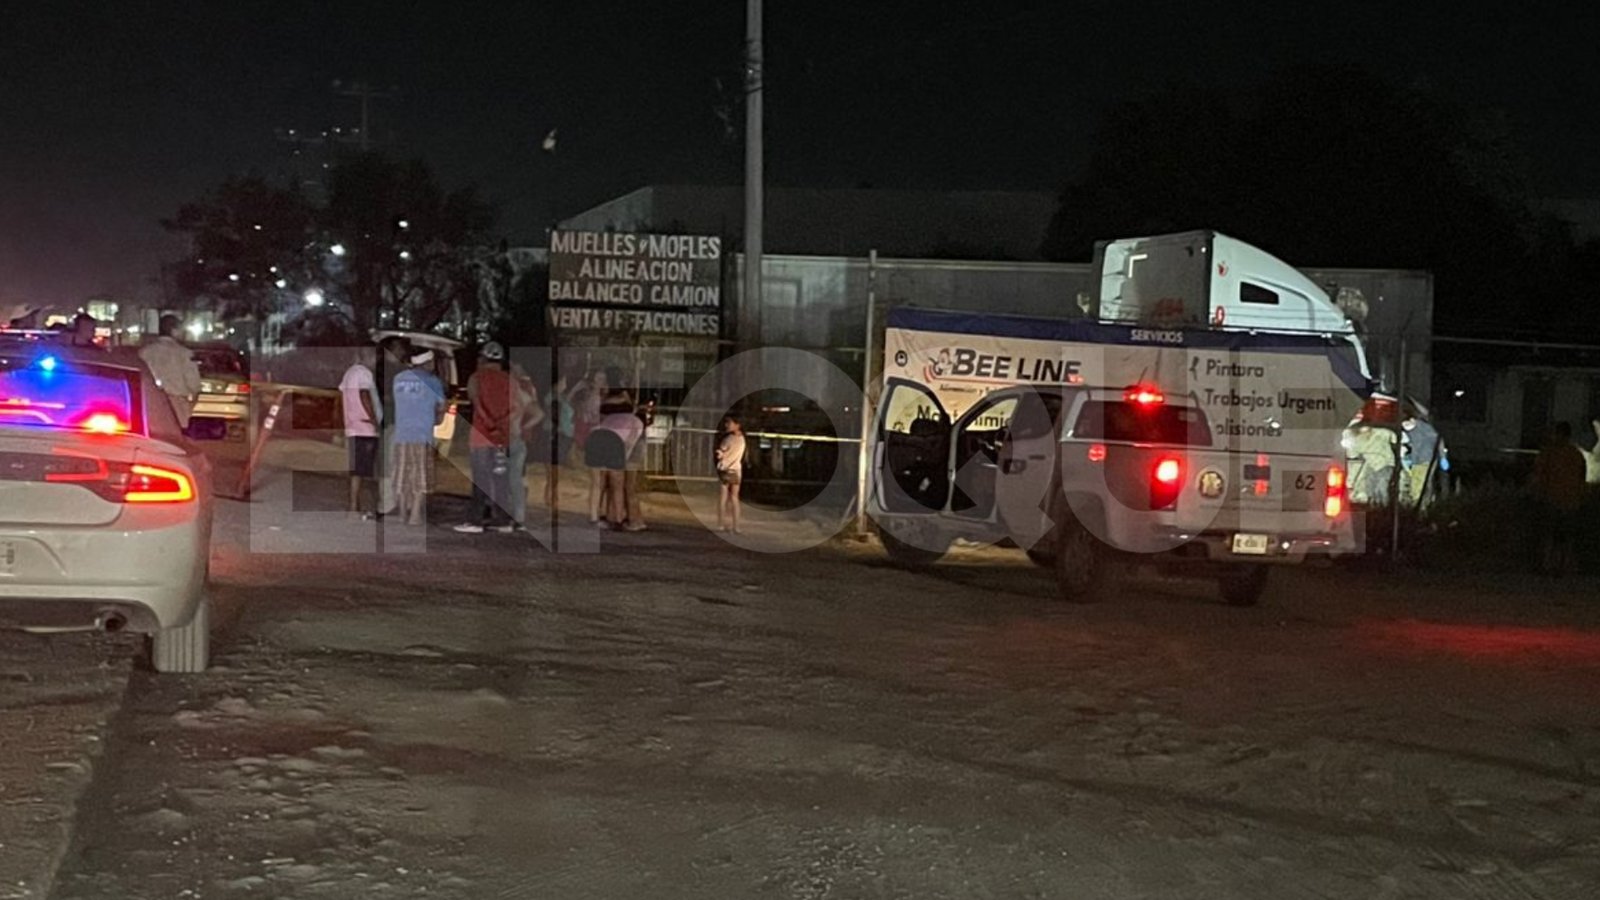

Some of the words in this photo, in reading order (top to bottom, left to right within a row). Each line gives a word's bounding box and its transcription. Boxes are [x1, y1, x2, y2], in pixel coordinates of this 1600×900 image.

[551, 231, 636, 255] MUELLES
[649, 234, 722, 259] MOFLES
[579, 258, 693, 282] ALINEACION
[549, 280, 642, 303] BALANCEO
[650, 284, 720, 307] CAMION
[549, 306, 600, 330] VENTA
[1130, 328, 1184, 344] SERVICIOS
[951, 348, 1012, 378] BEE
[1016, 358, 1081, 382] LINE
[1206, 358, 1265, 379] Pintura
[1205, 387, 1273, 413] Trabajos
[1294, 475, 1315, 491] 62
